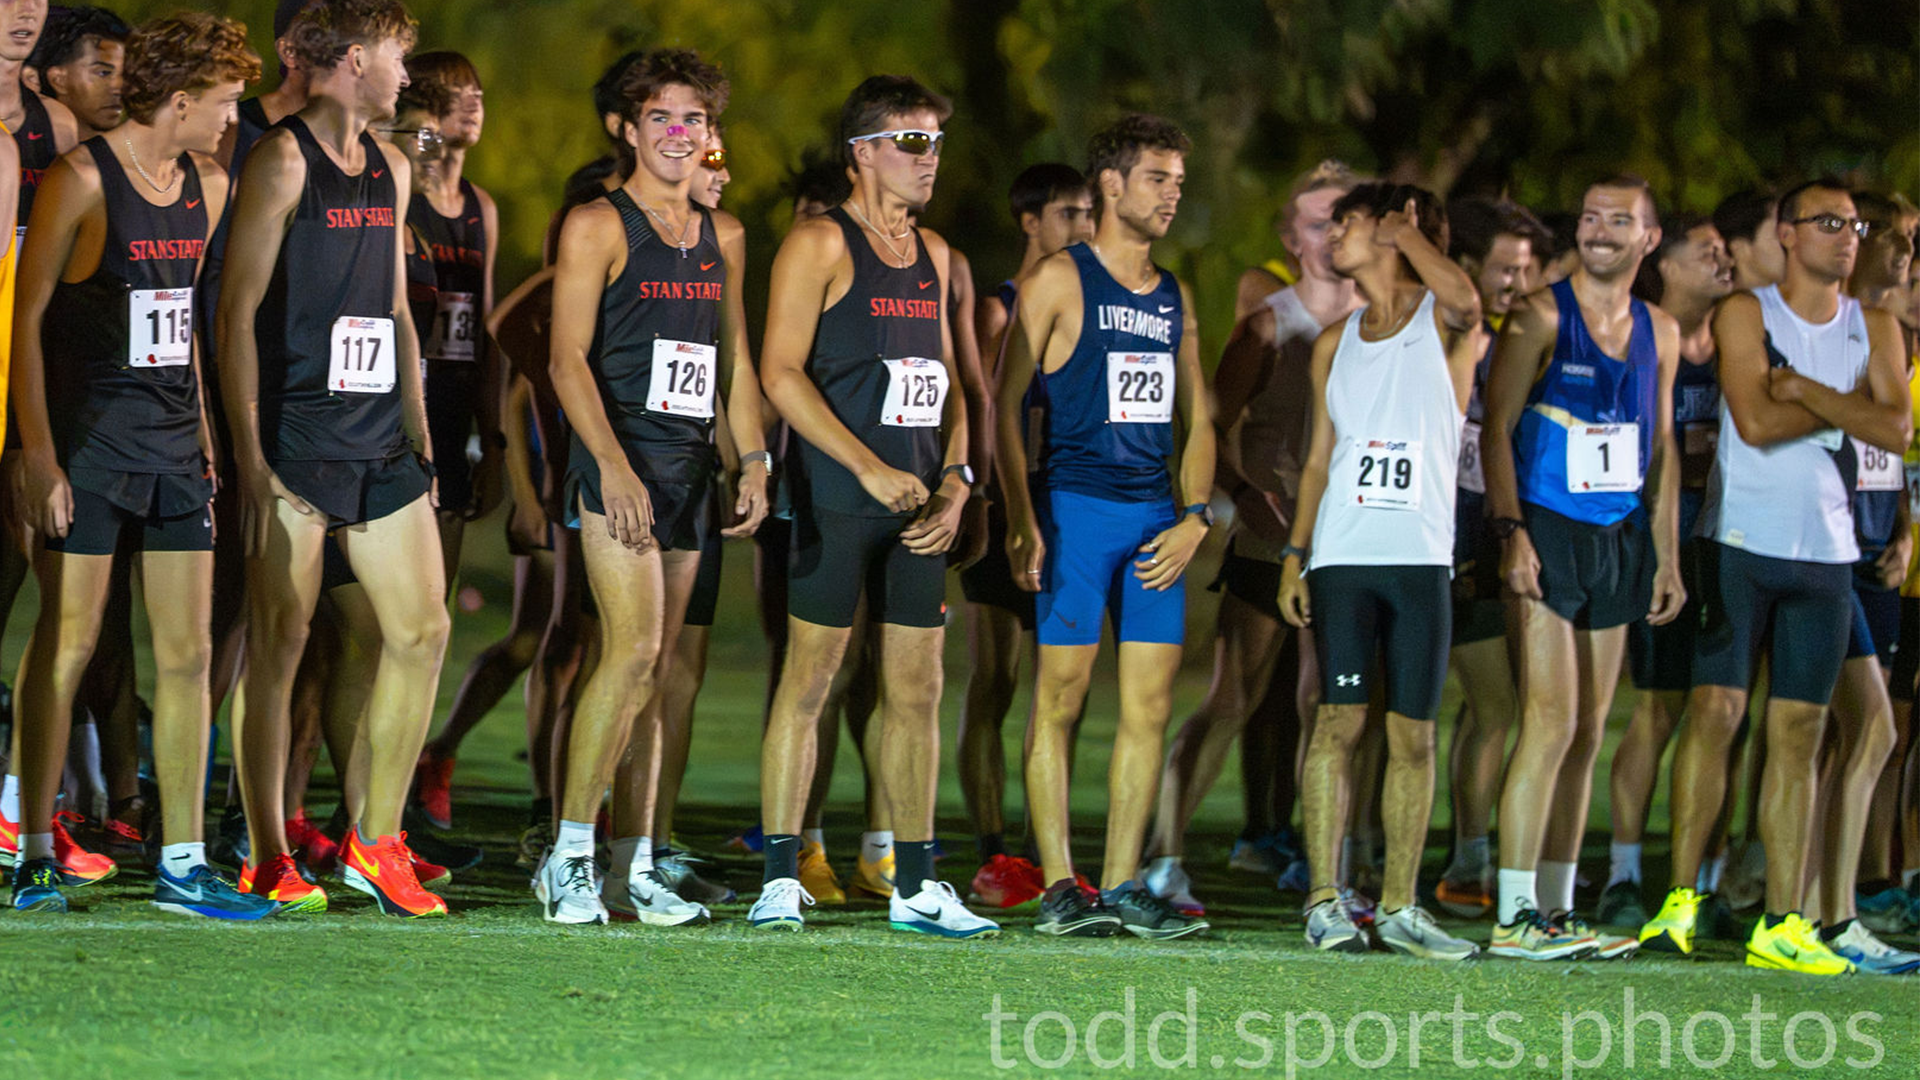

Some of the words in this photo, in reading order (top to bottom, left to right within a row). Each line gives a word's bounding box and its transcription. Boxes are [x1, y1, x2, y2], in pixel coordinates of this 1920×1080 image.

[326, 208, 363, 228] STAN
[128, 239, 166, 261] STAN
[639, 281, 683, 300] STAN
[685, 282, 722, 301] STATE
[870, 298, 905, 318] STAN
[906, 300, 938, 320] STATE
[1098, 304, 1172, 346] LIVERMORE
[146, 308, 190, 345] 115
[341, 335, 382, 372] 117
[667, 359, 707, 397] 126
[902, 374, 939, 408] 125
[1118, 370, 1164, 403] 223
[1357, 455, 1412, 491] 219
[1597, 441, 1610, 473] 1
